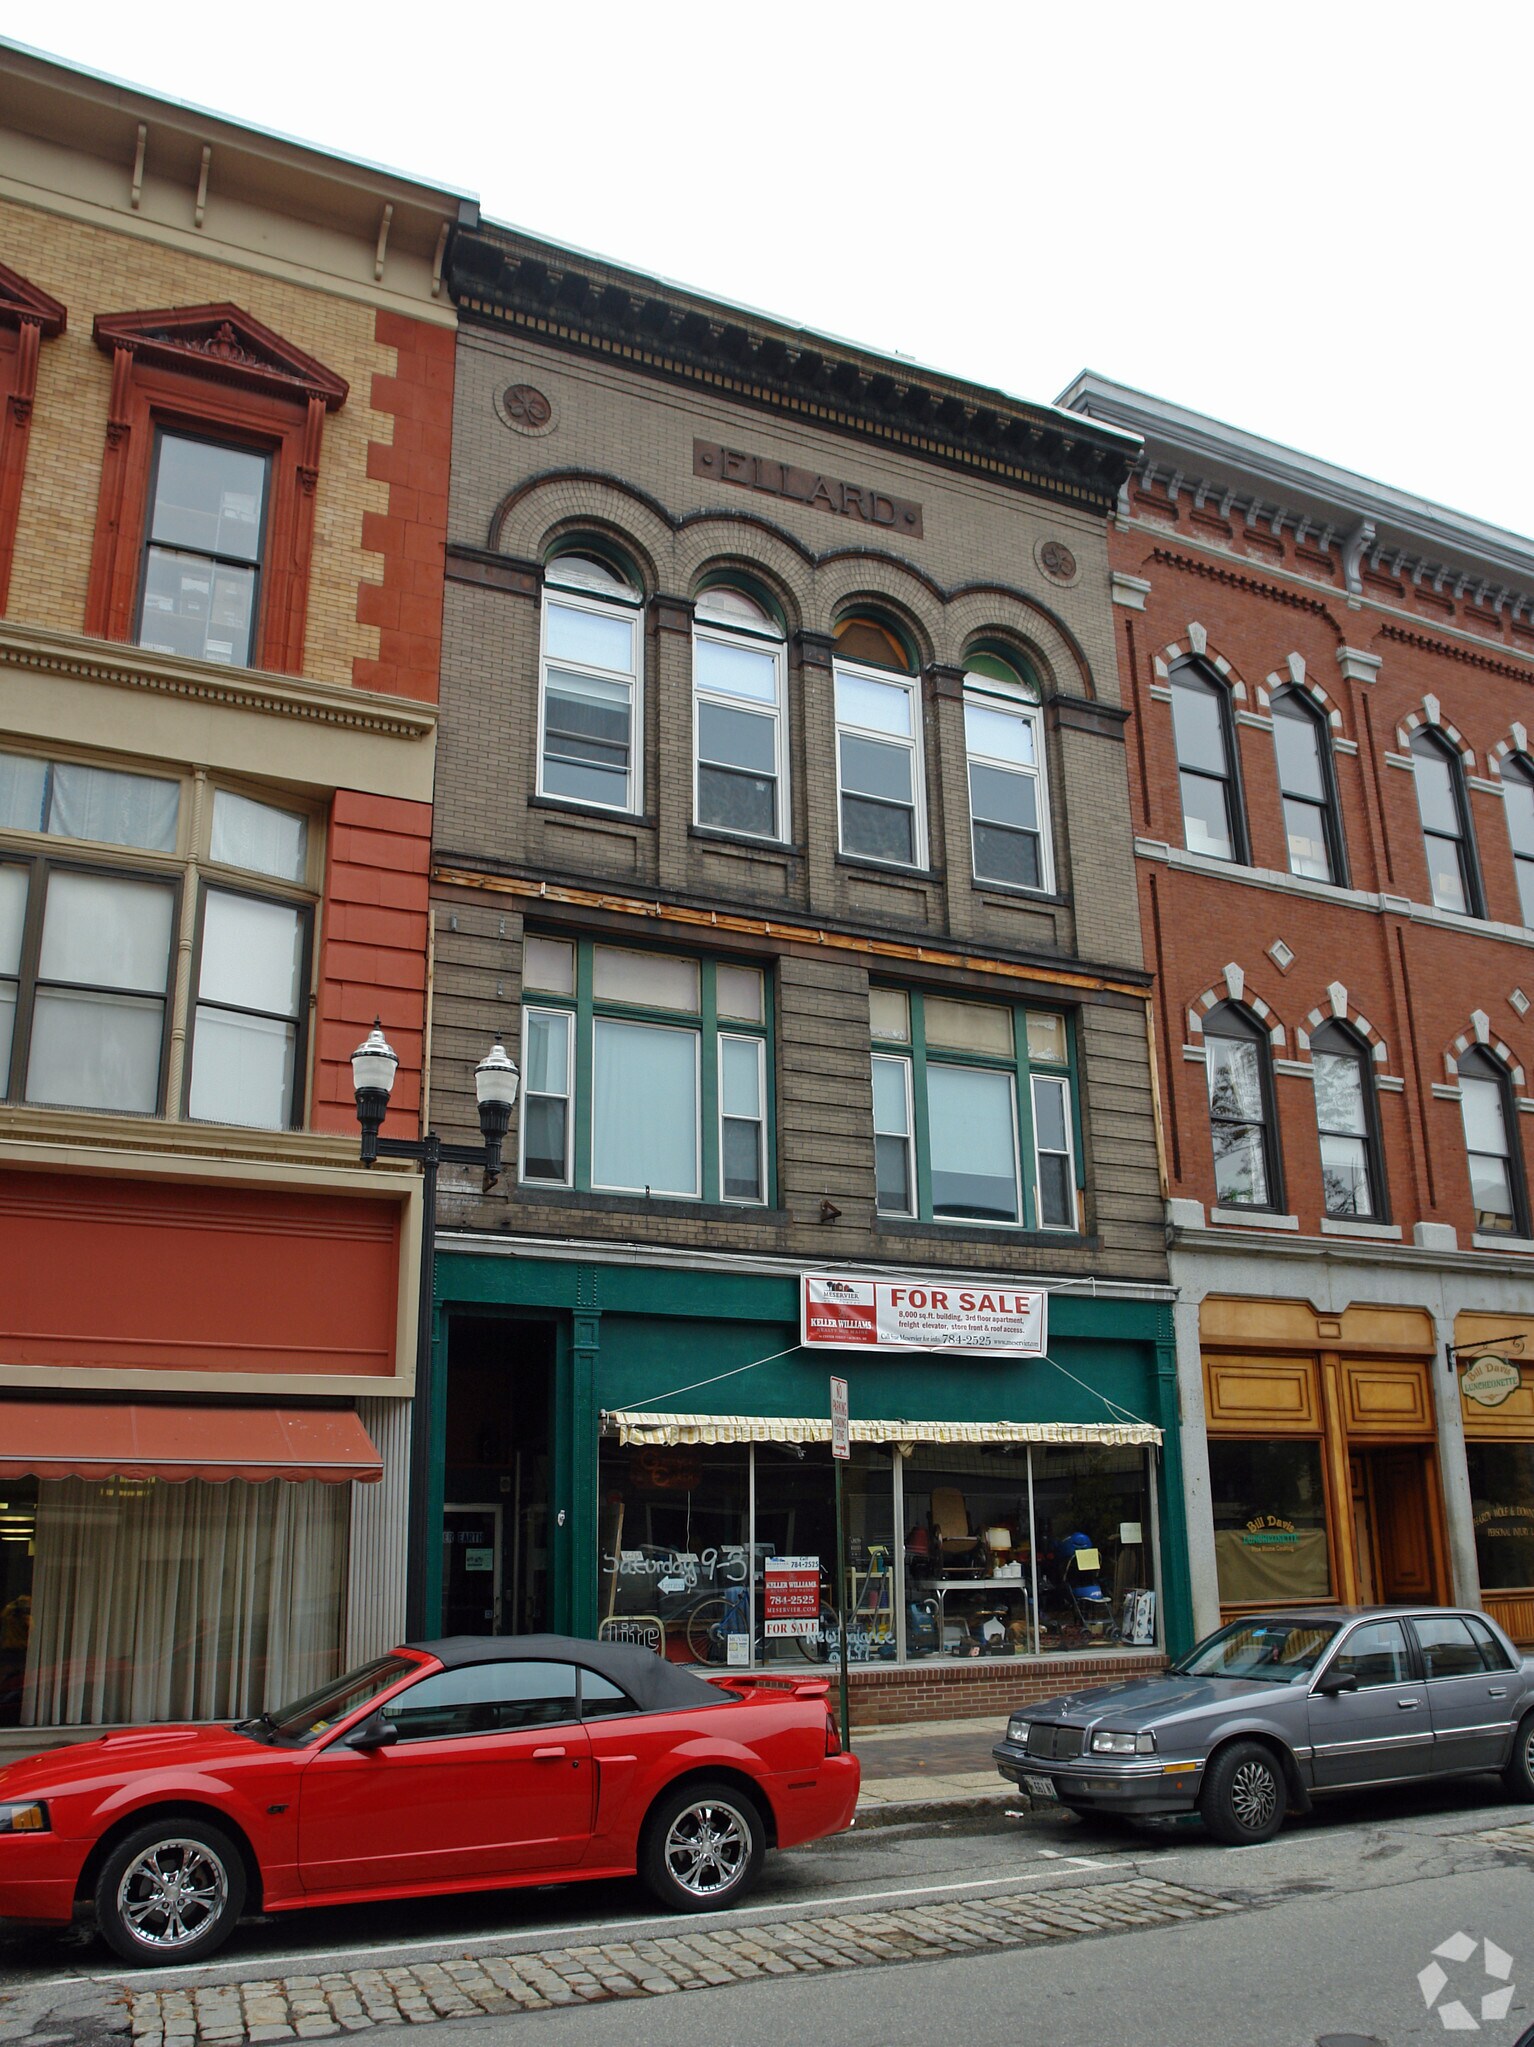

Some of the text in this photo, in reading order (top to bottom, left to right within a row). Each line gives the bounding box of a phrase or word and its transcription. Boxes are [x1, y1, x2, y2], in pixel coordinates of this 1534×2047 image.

[721, 448, 896, 525] ELLARD
[823, 1291, 860, 1300] MESERVIER
[891, 1288, 1030, 1315] FOR SALE
[811, 1317, 872, 1330] KELLER WILLIAMS
[898, 1310, 918, 1319] 8,000
[992, 1316, 1024, 1325] apartment,
[898, 1320, 920, 1330] freight
[922, 1321, 949, 1331] elevator,
[951, 1323, 967, 1331] store
[968, 1323, 984, 1332] front
[984, 1324, 990, 1332] &
[991, 1325, 1003, 1333] roof
[942, 1333, 992, 1346] 784-2525
[1467, 1362, 1512, 1382] Bill Davis
[1464, 1376, 1518, 1392] LUNCHEONETTE
[1246, 1515, 1295, 1534] Bill Davis
[603, 1547, 748, 1588] Saturday 9-3
[766, 1580, 816, 1589] KELLER WILLIAMS
[769, 1595, 815, 1605] 784-2525
[767, 1622, 818, 1634] FOR SALE
